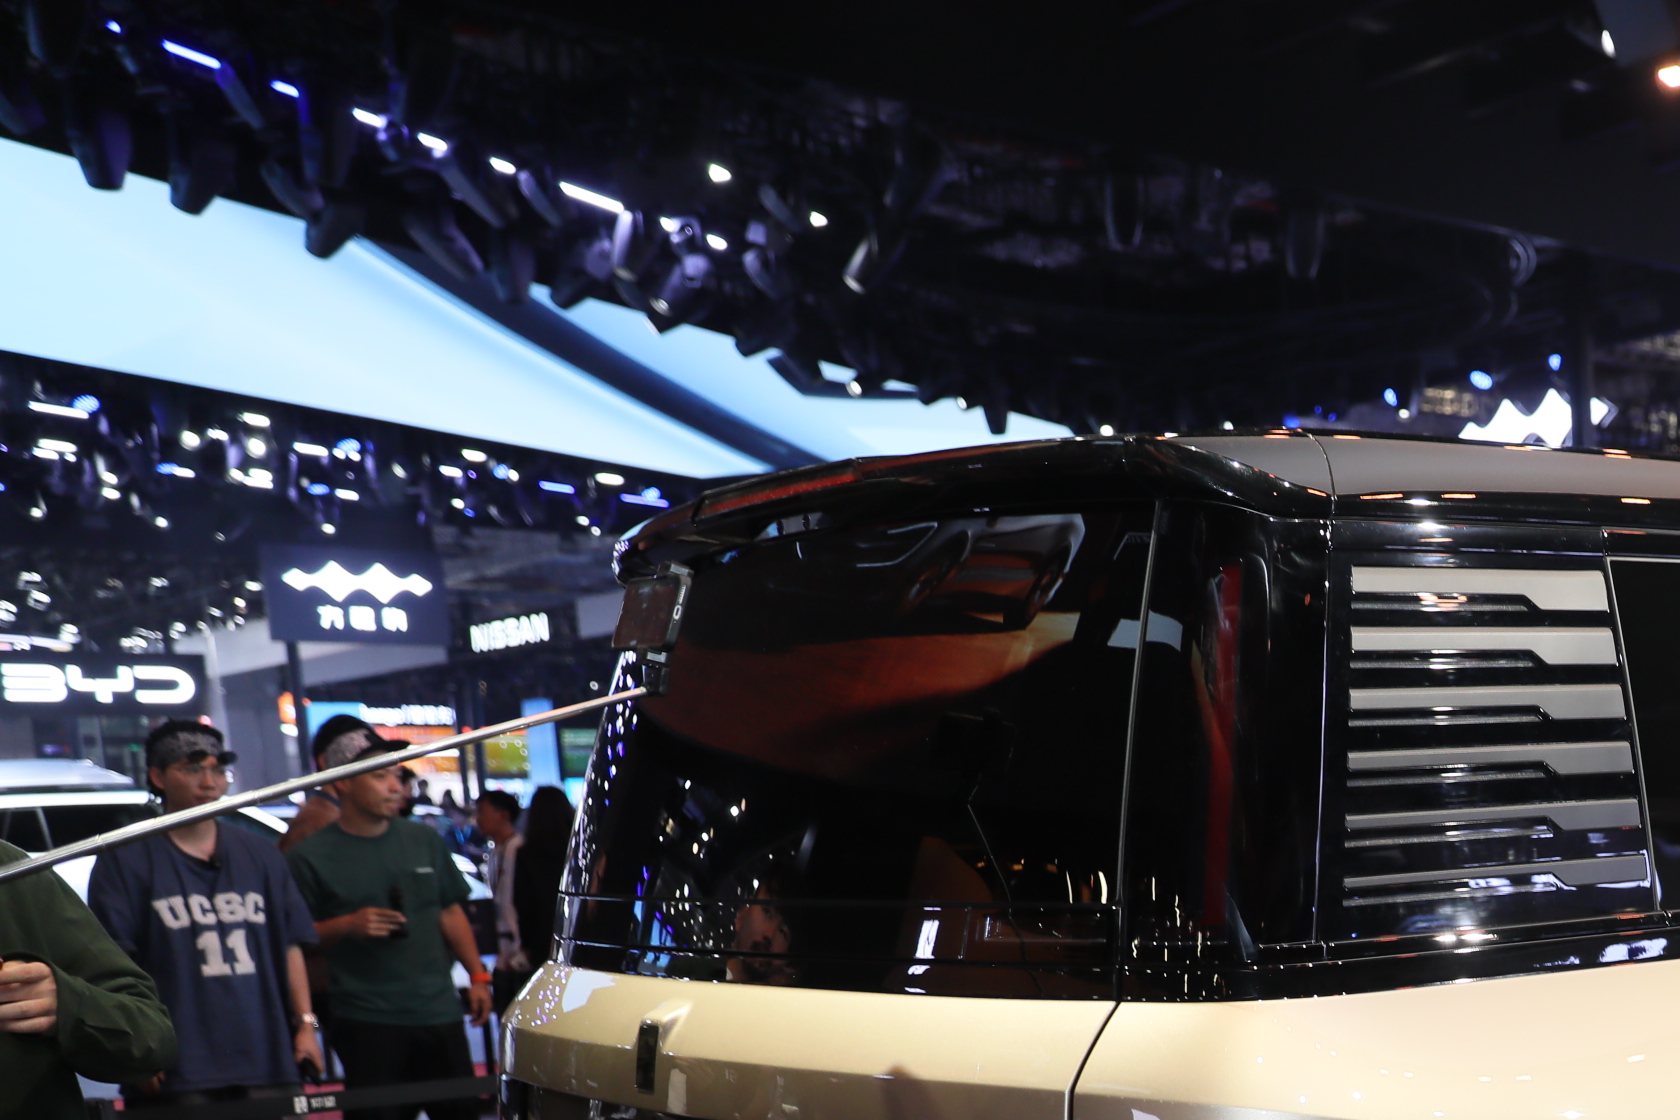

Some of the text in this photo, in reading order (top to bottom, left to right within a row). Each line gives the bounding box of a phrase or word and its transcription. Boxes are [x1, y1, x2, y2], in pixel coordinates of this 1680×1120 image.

[470, 612, 550, 653] NISSAN
[1, 663, 196, 704] BYD
[152, 891, 266, 929] UCSC
[196, 929, 256, 977] 11
